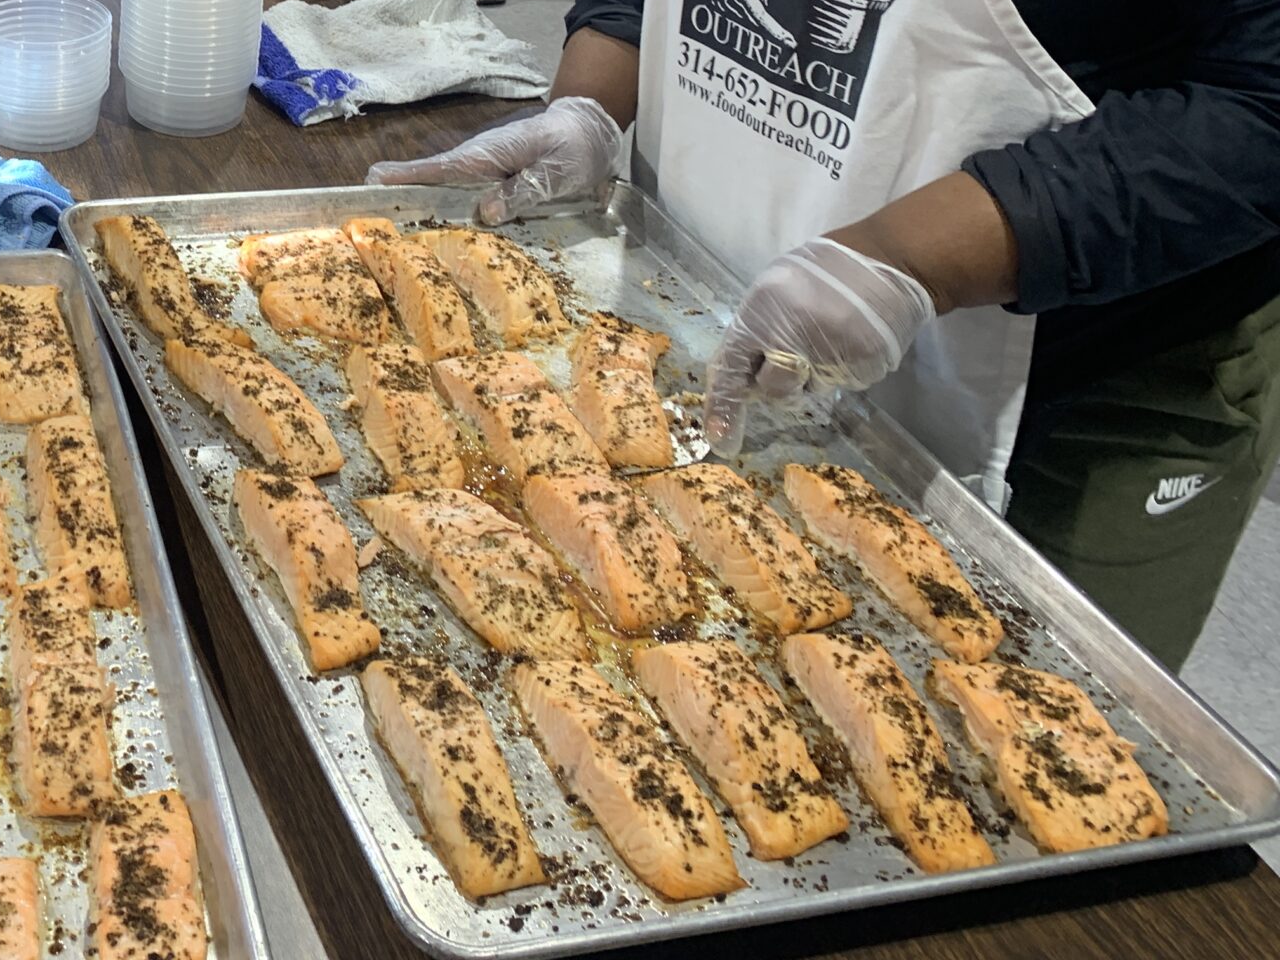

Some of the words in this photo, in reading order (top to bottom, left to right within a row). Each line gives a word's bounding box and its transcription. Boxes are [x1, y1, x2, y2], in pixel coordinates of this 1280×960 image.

[677, 42, 852, 152] 314-652-FOOD
[689, 3, 858, 107] OUTREACH
[677, 72, 844, 181] www.foodoutreach.org
[1157, 473, 1205, 500] NIKE
